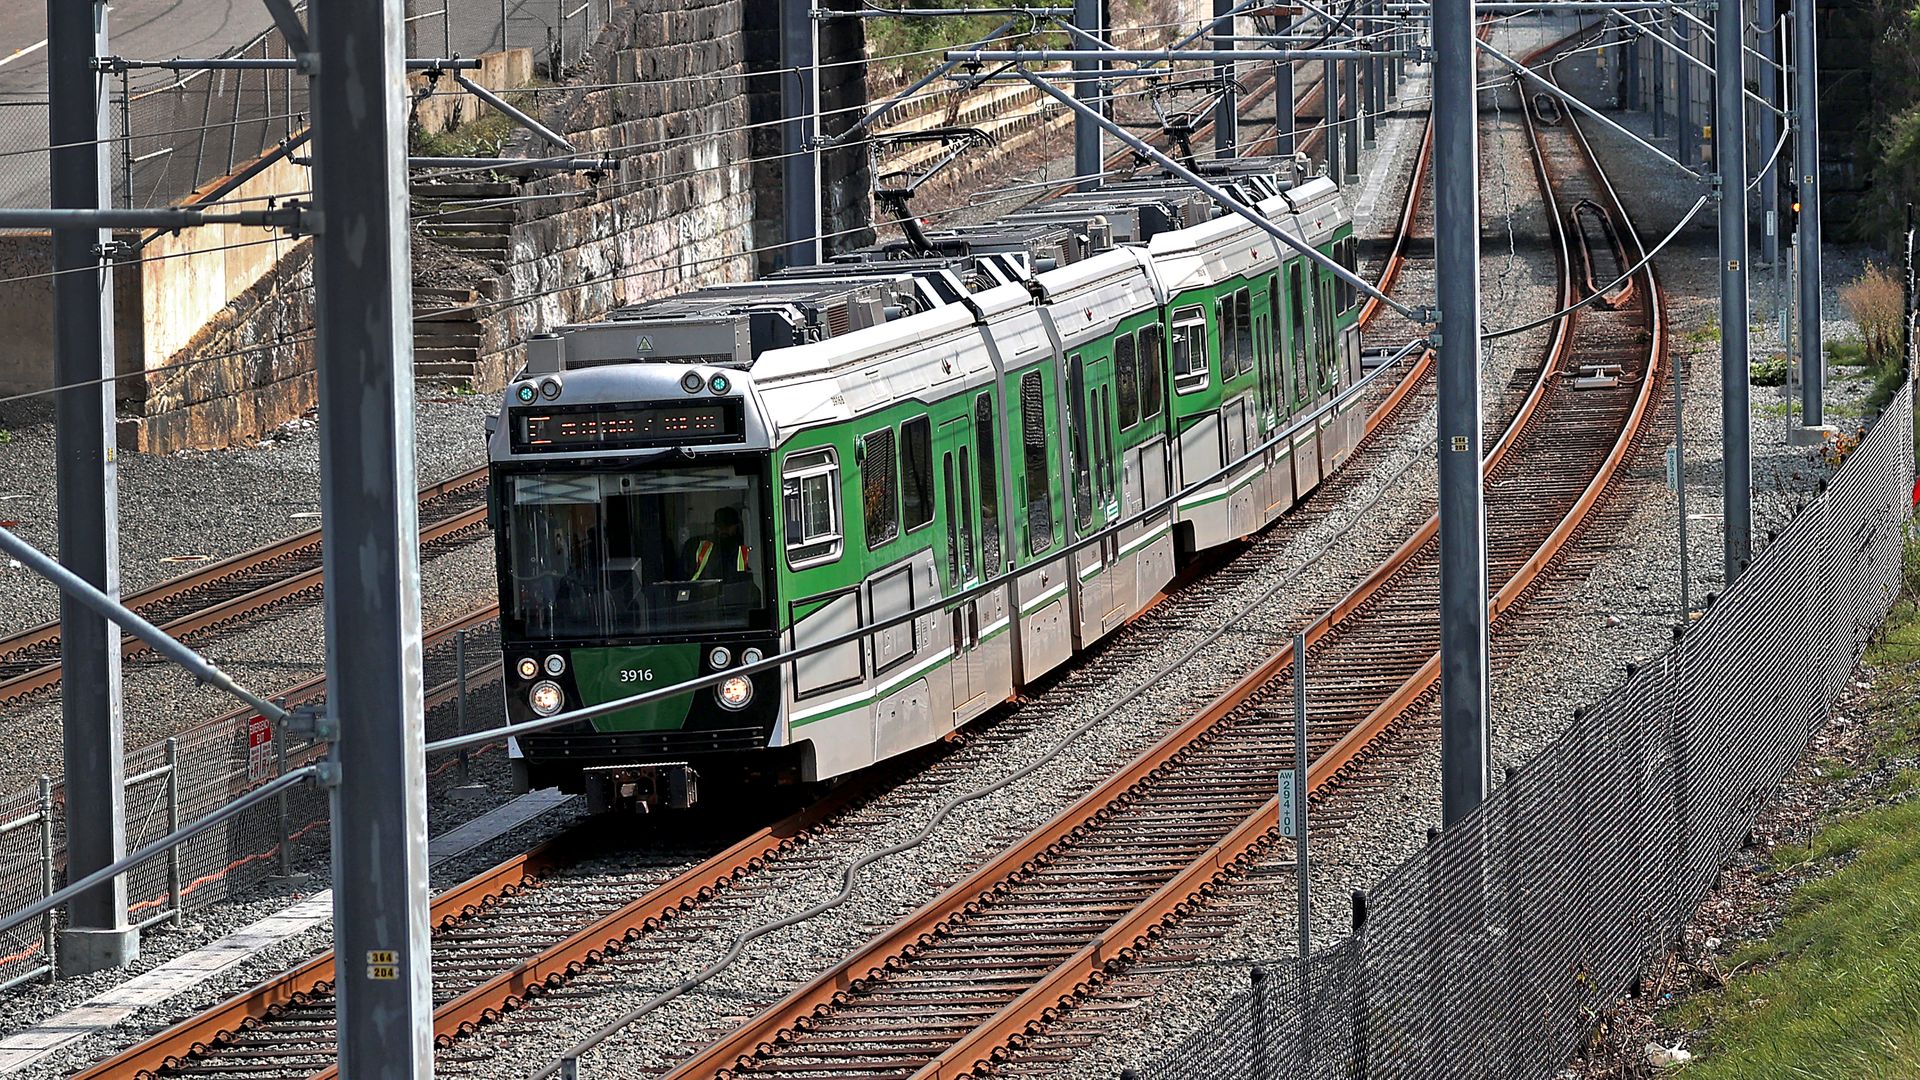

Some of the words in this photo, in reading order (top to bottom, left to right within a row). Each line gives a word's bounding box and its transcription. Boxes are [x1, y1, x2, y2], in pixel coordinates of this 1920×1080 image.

[620, 669, 653, 682] 3916
[1283, 780, 1291, 835] 294+00
[372, 952, 392, 962] 364
[374, 967, 393, 978] 204
